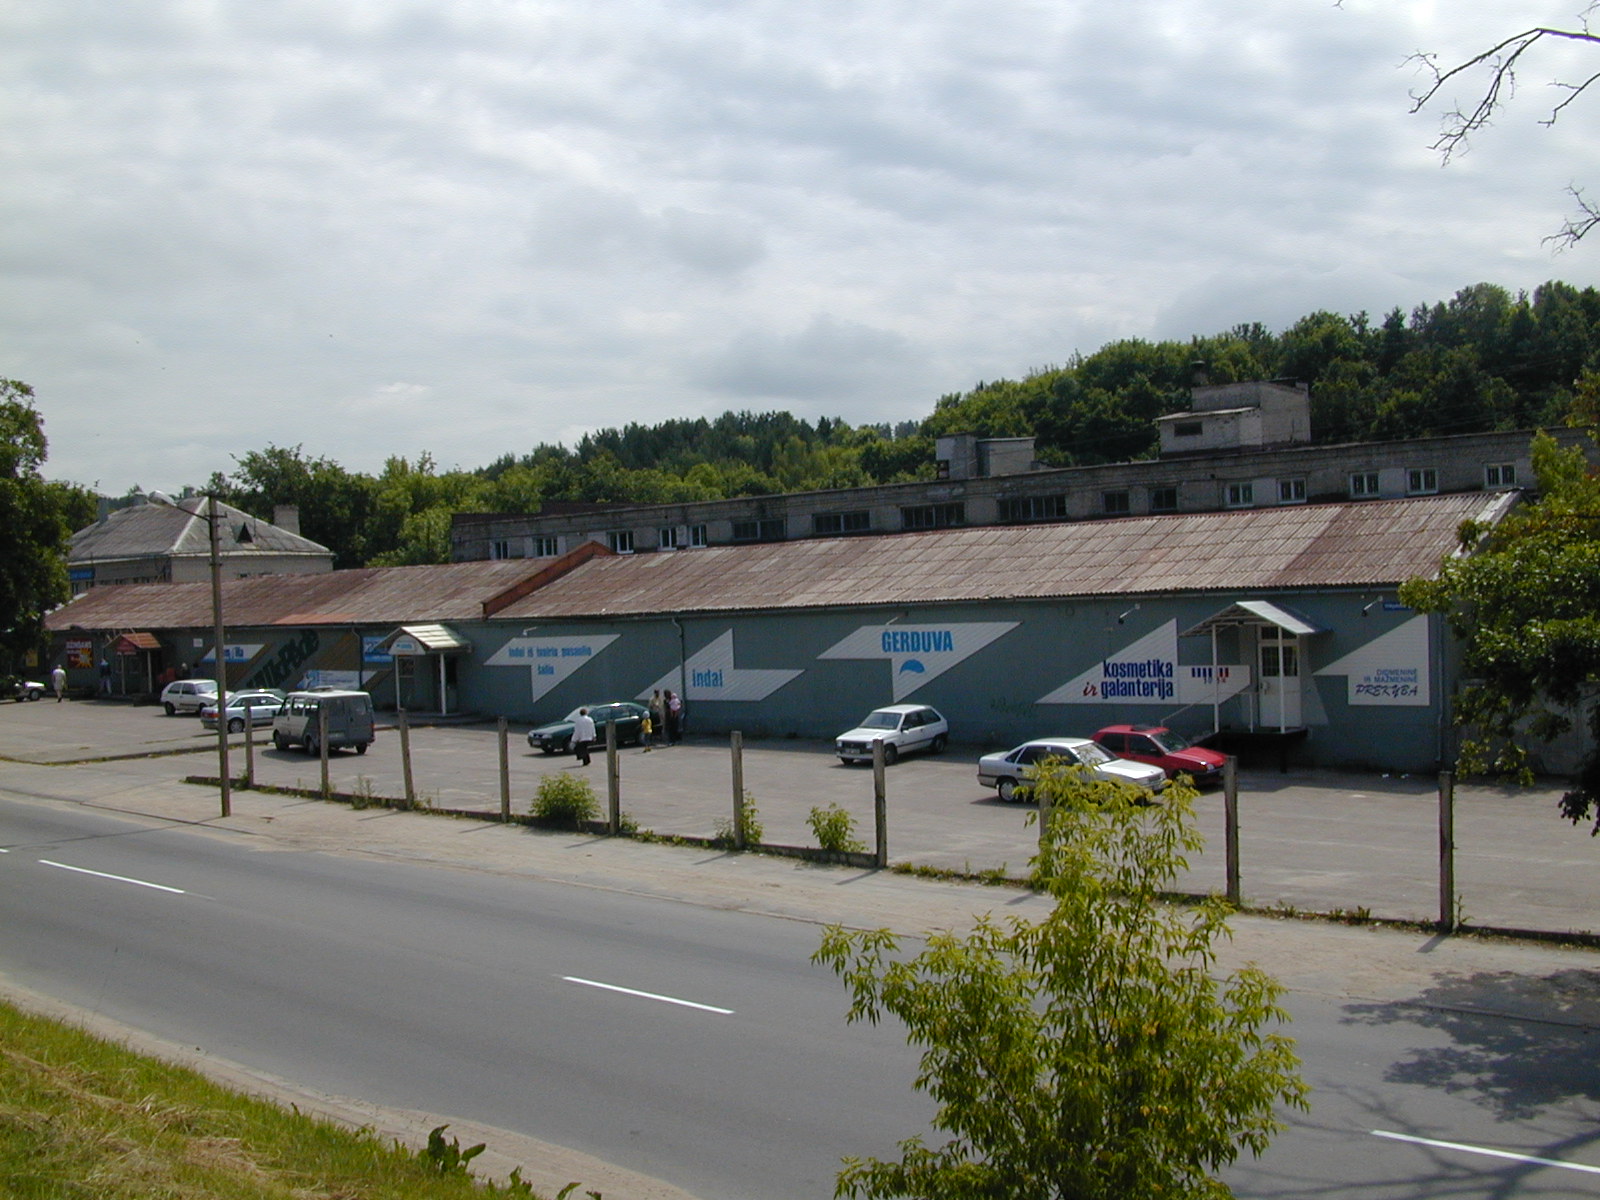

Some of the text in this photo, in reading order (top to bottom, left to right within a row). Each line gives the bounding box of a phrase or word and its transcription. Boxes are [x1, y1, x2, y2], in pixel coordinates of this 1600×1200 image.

[1103, 659, 1173, 678] kosmetika
[692, 669, 723, 688] indai
[1083, 678, 1173, 700] ir galanterija
[1355, 684, 1418, 698] PREKYBA
